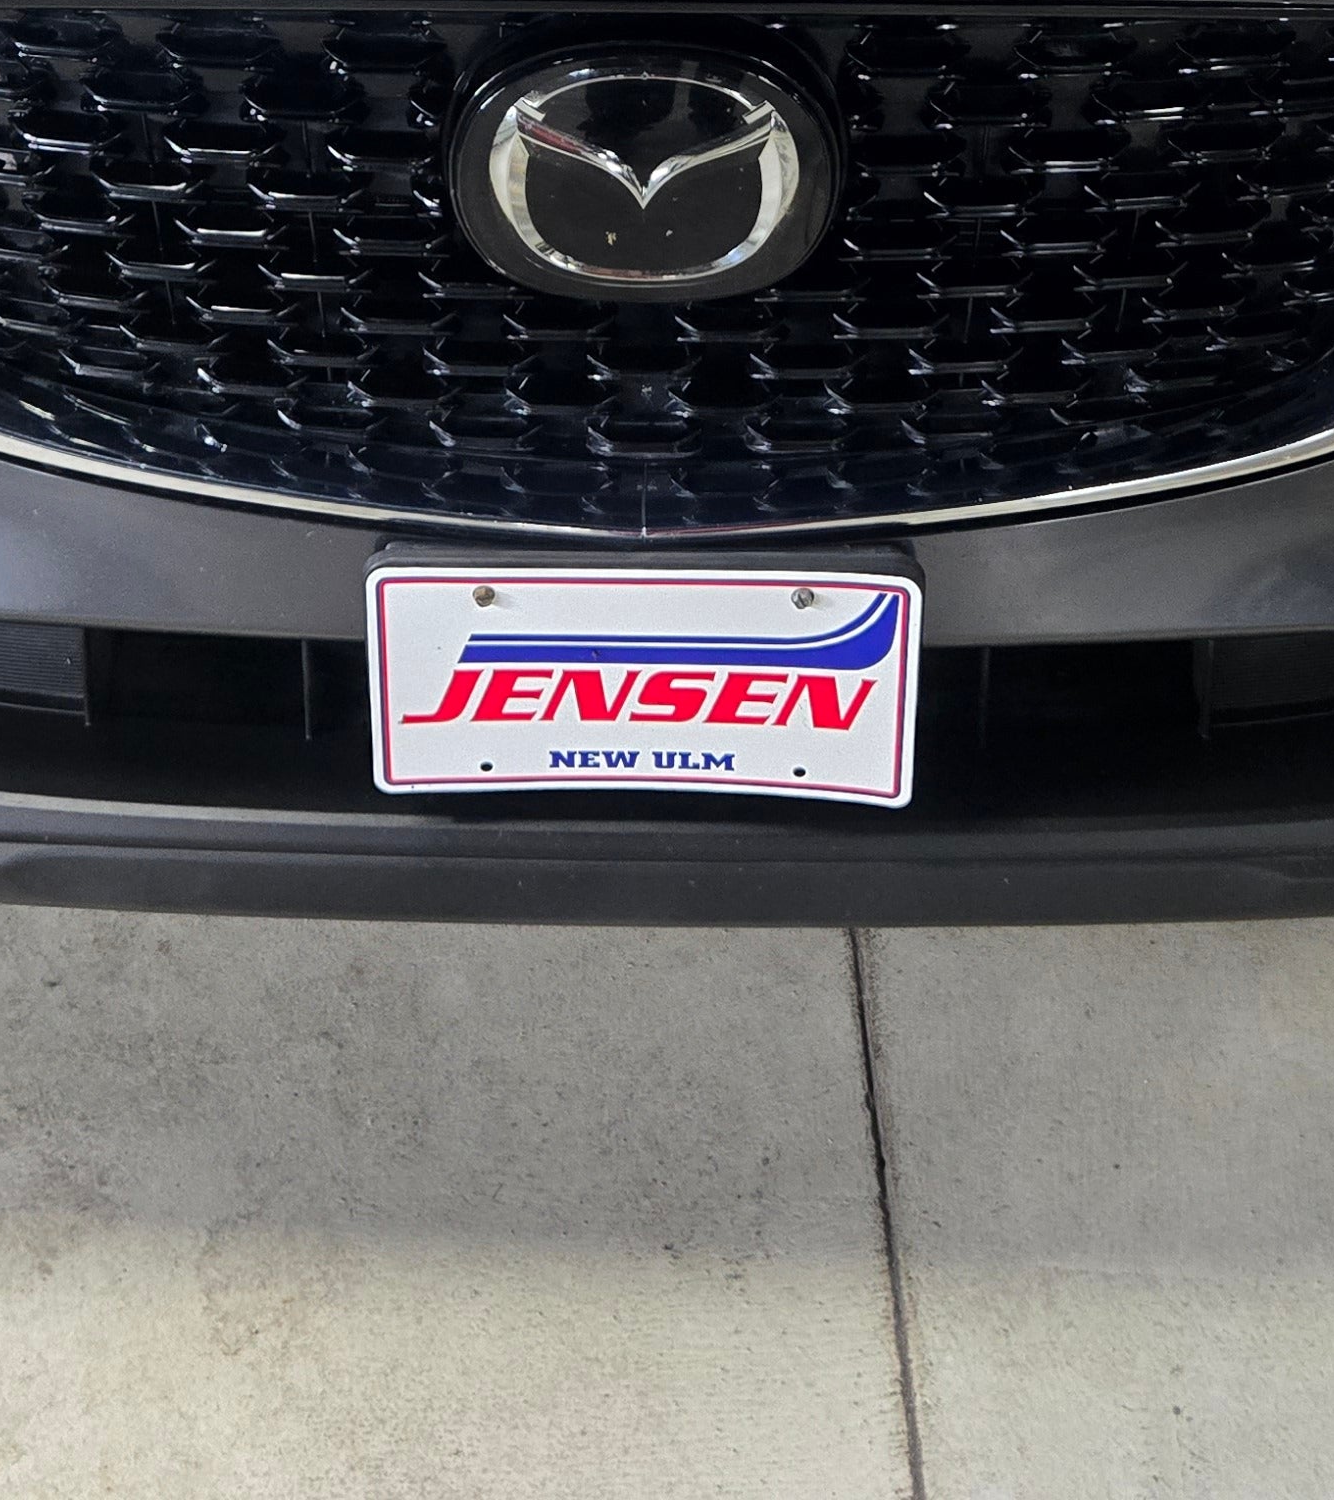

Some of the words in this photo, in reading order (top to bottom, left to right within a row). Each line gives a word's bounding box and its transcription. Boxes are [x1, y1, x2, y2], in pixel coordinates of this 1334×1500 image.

[400, 668, 879, 731] JENSEN
[549, 750, 641, 770] NEW
[652, 751, 736, 772] ULM
